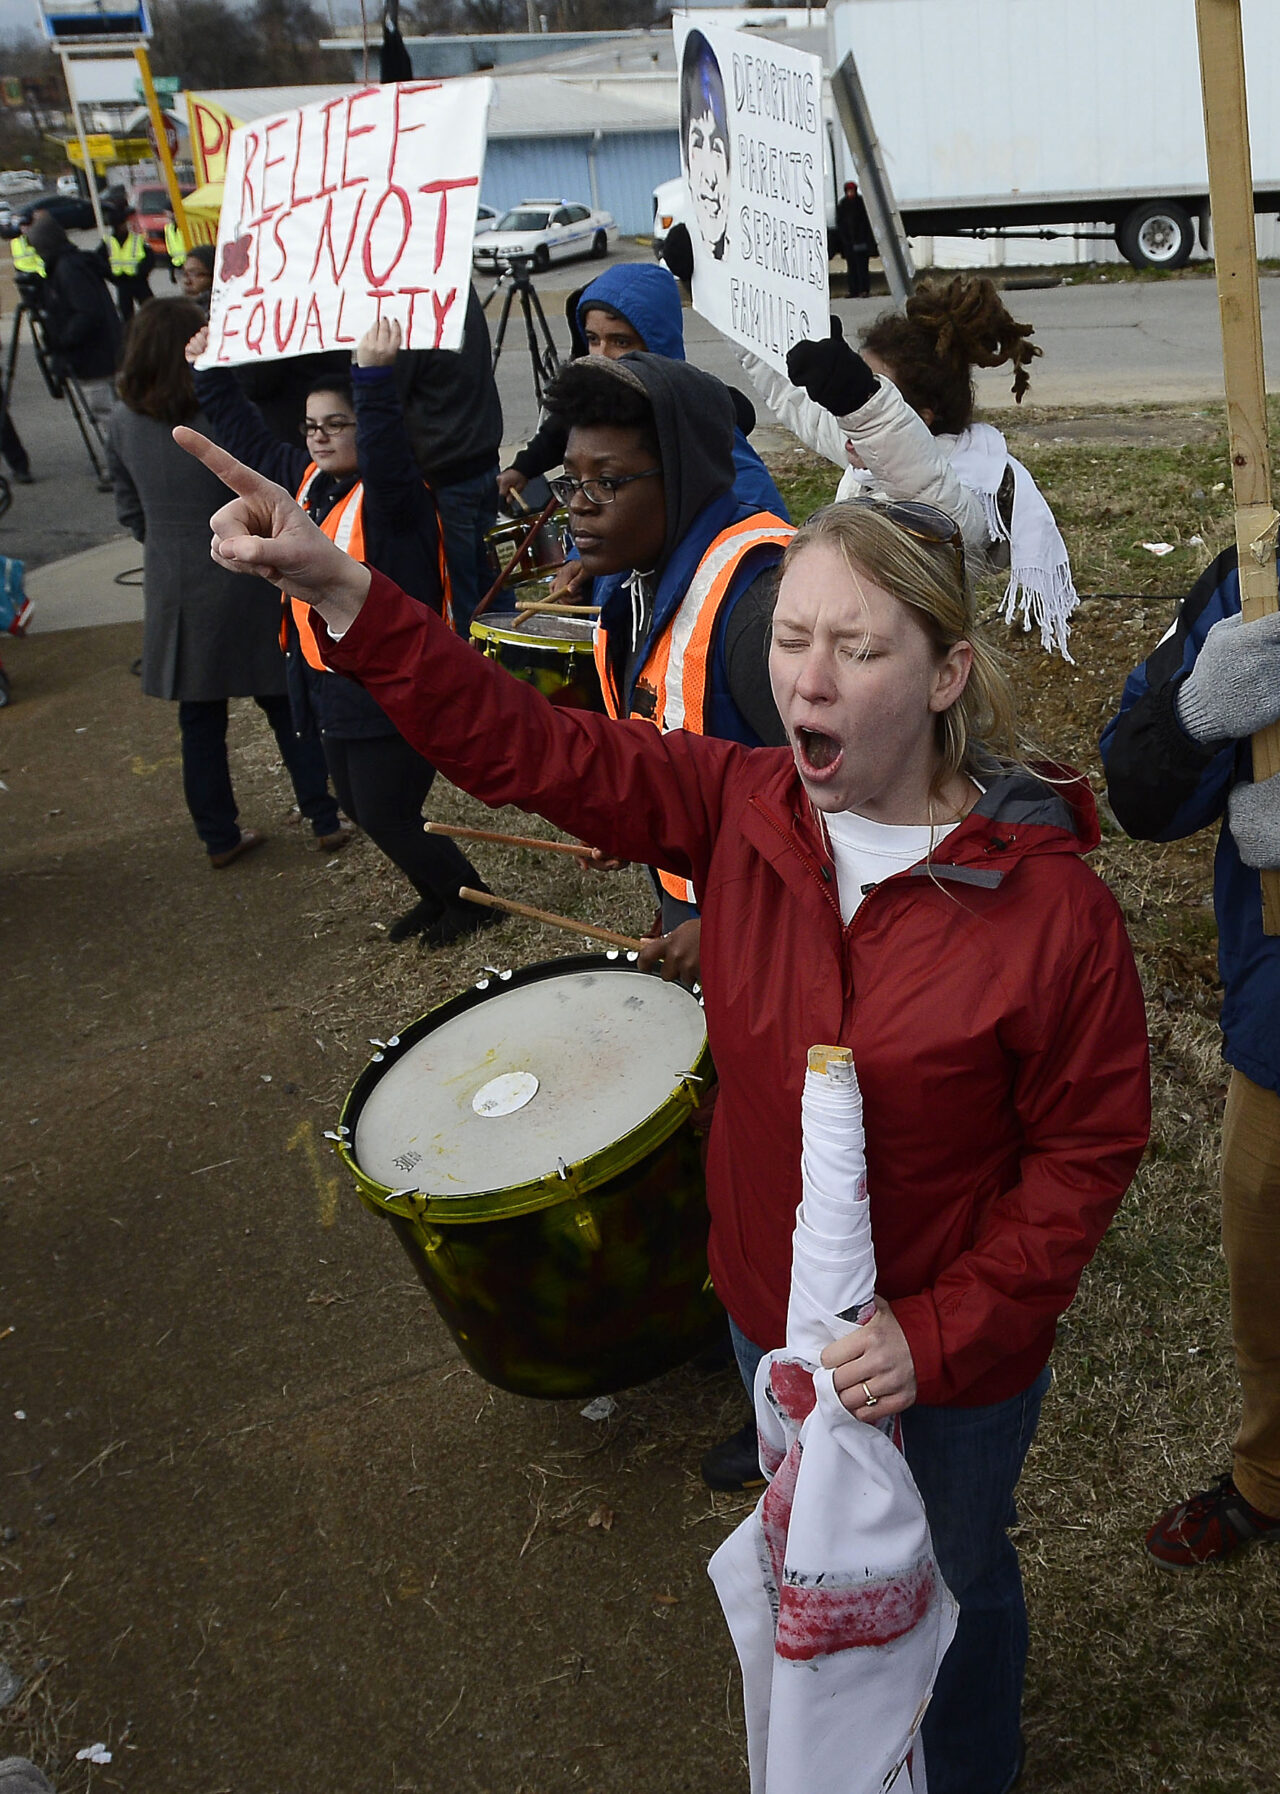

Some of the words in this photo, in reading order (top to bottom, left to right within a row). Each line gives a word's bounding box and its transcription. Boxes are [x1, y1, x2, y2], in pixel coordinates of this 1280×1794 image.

[239, 81, 443, 224] RELIEF
[738, 133, 815, 215] PARENTS
[243, 210, 292, 298] IS
[308, 176, 479, 288] NOT
[740, 205, 825, 291] SEPARATES
[217, 286, 458, 362] EQUALITY
